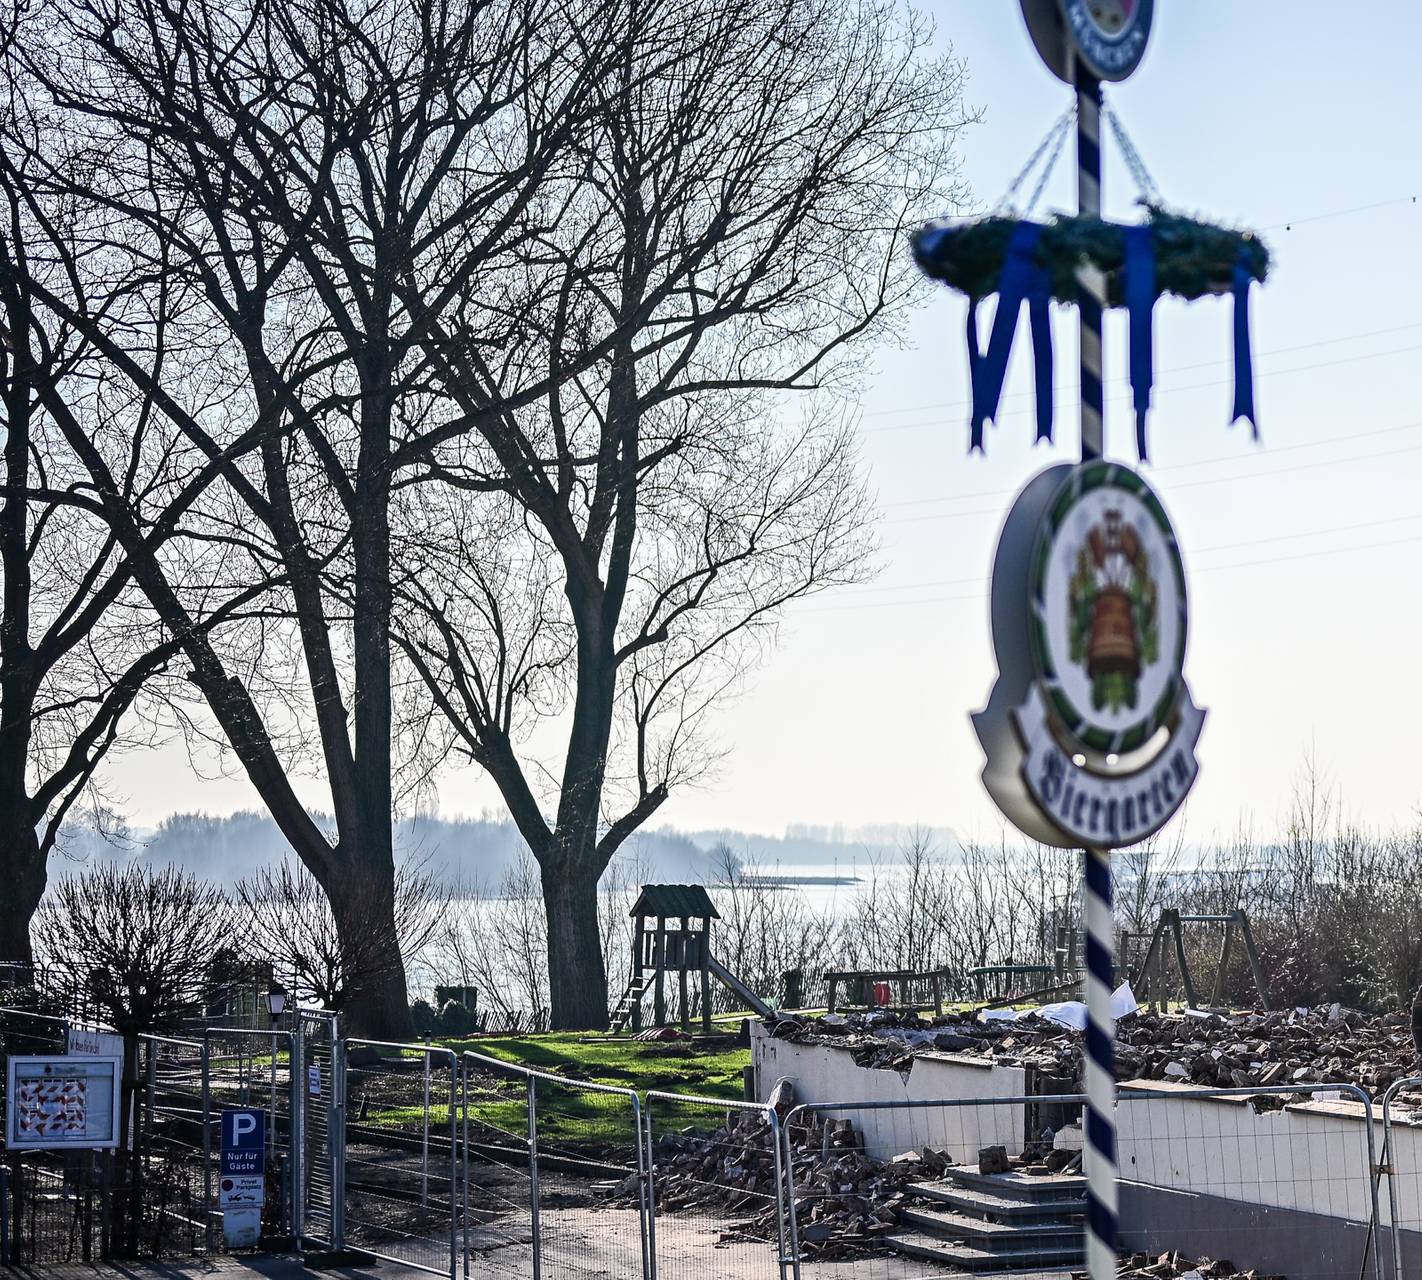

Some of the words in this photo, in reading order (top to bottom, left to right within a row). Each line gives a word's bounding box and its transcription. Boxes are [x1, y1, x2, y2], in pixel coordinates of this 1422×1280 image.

[1040, 748, 1190, 846] Biergarten
[232, 1113, 257, 1146] P
[227, 1152, 243, 1160] Nur
[245, 1152, 257, 1160] für
[229, 1162, 255, 1170] Gäste
